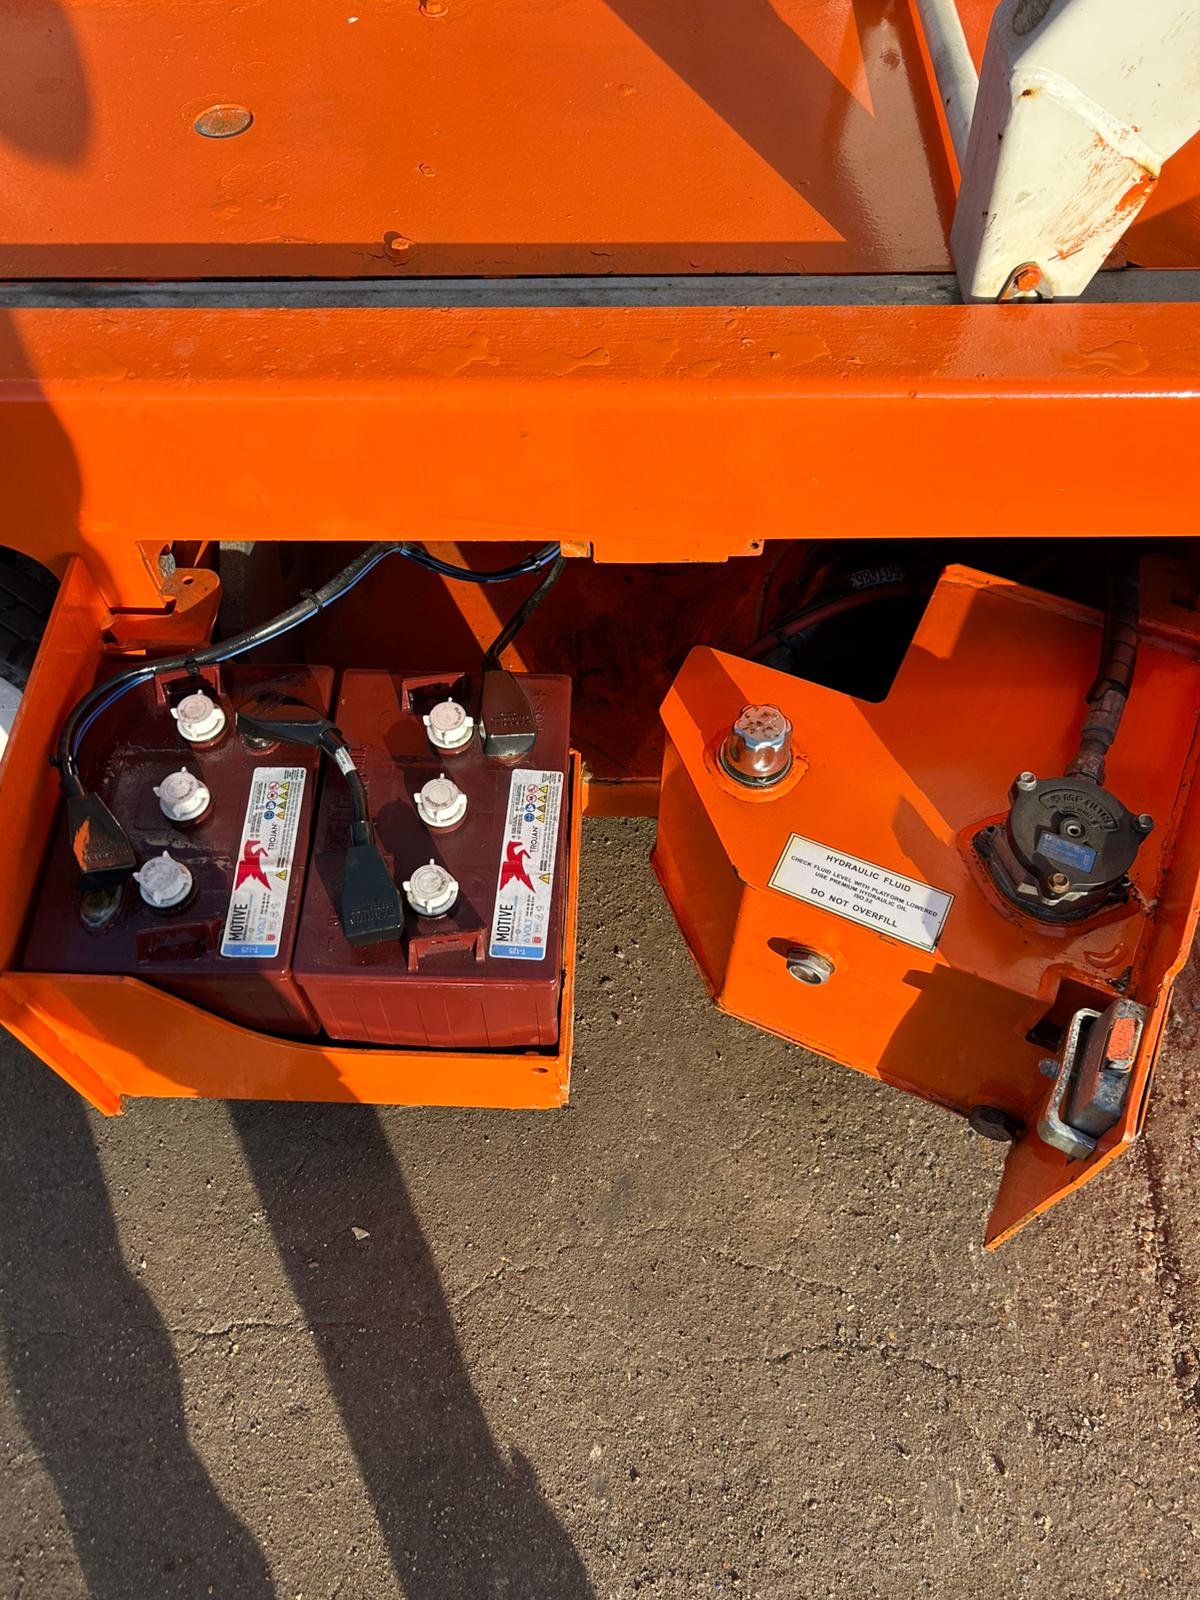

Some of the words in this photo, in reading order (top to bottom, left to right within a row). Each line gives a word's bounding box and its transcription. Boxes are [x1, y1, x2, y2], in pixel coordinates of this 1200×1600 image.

[267, 824, 277, 850] TROJAN
[529, 826, 538, 852] TROJAN
[791, 855, 812, 868] CHECK
[814, 864, 832, 875] FLUID
[833, 871, 852, 884] LEVEL
[854, 880, 870, 890] WITH
[872, 887, 905, 904] PLATFORM
[906, 900, 938, 917] LOWERED
[815, 871, 828, 881] USE
[829, 877, 858, 892] PREMIUM
[859, 889, 895, 908] HYDRAULIC
[896, 904, 907, 913] OIL
[826, 854, 879, 880] HYDRAULIC
[883, 876, 911, 893] FLUID
[811, 887, 825, 898] DO
[829, 894, 849, 907] NOT
[852, 904, 898, 928] OVERFILL
[854, 892, 864, 901] ISO
[865, 897, 873, 905] 32
[227, 903, 247, 940] MOTIVE
[495, 903, 513, 941] MOTIVE
[522, 918, 532, 936] VOLT
[508, 946, 526, 955] T-125
